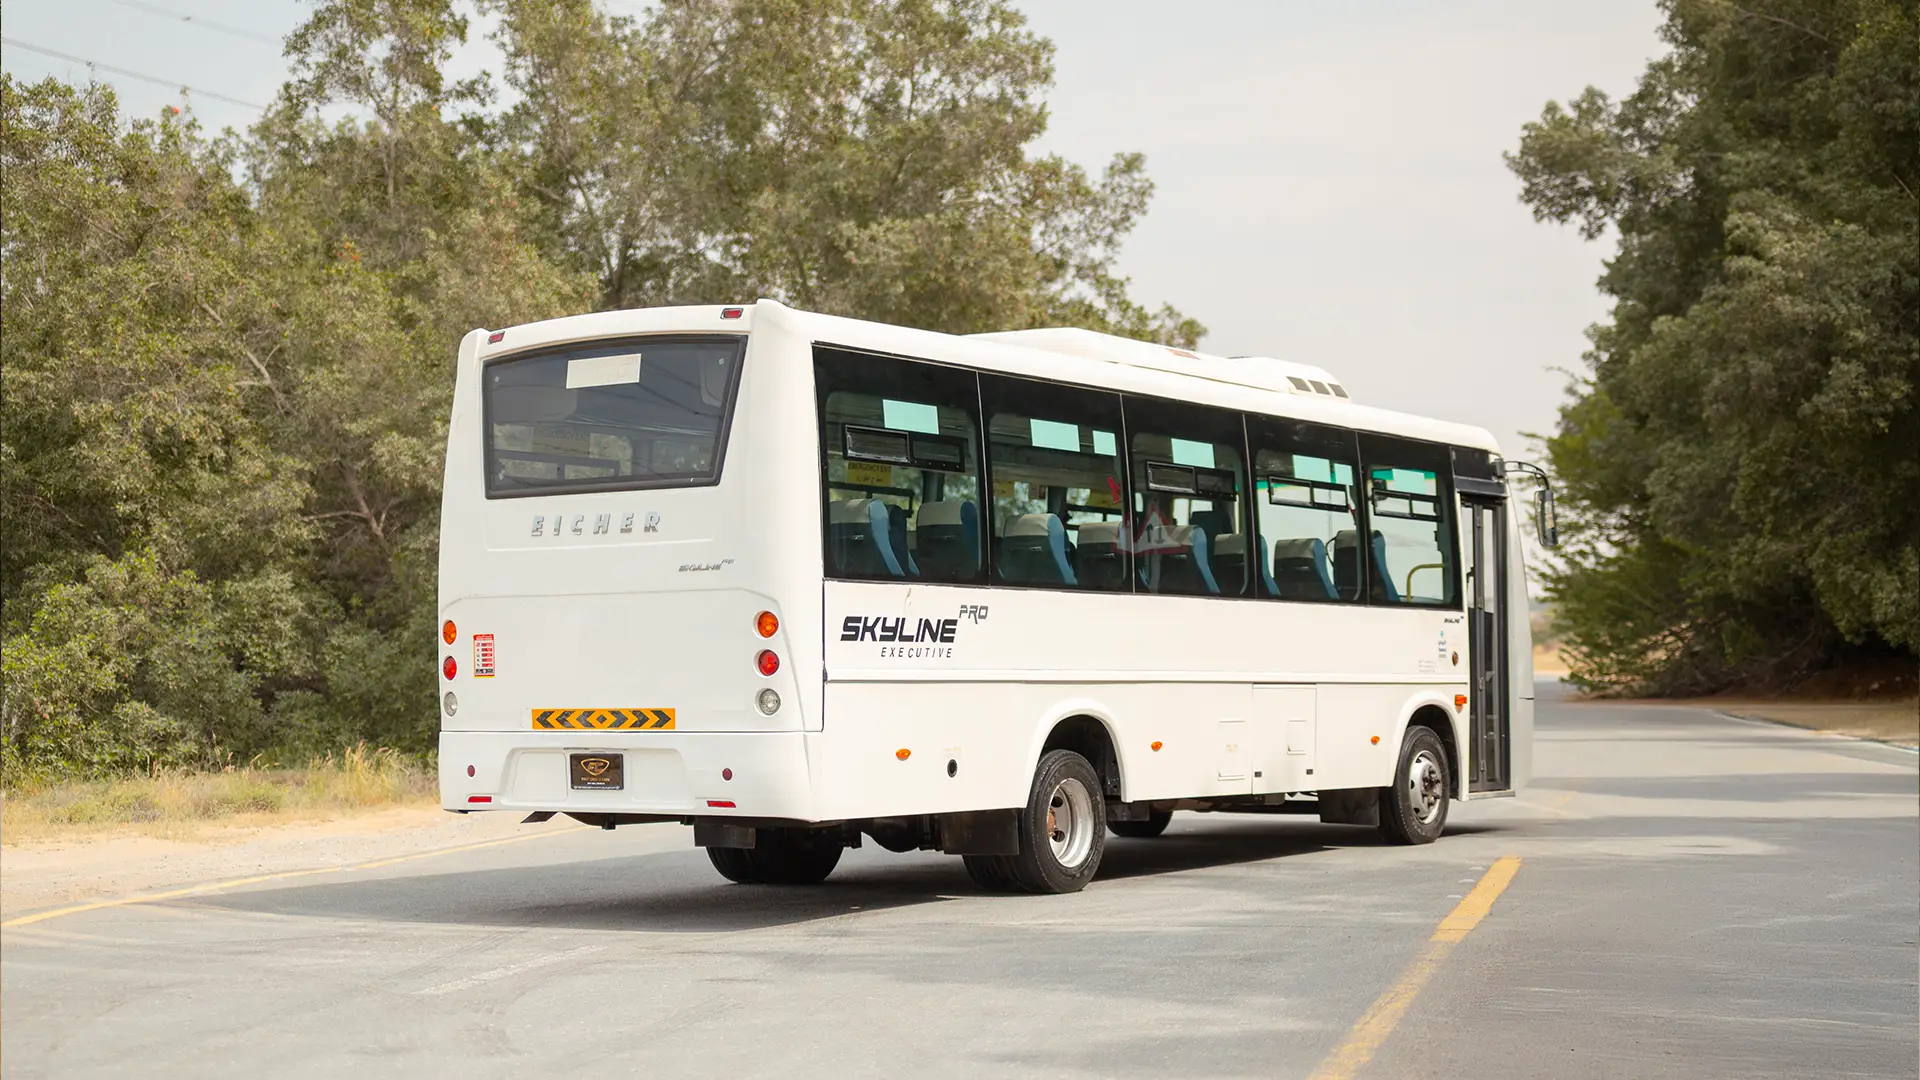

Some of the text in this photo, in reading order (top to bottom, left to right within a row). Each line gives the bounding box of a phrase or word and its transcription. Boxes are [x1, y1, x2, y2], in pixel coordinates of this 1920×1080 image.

[531, 511, 661, 537] EICHER
[840, 604, 989, 643] SKYLINE PRO
[881, 647, 953, 658] EXECUTIVE
